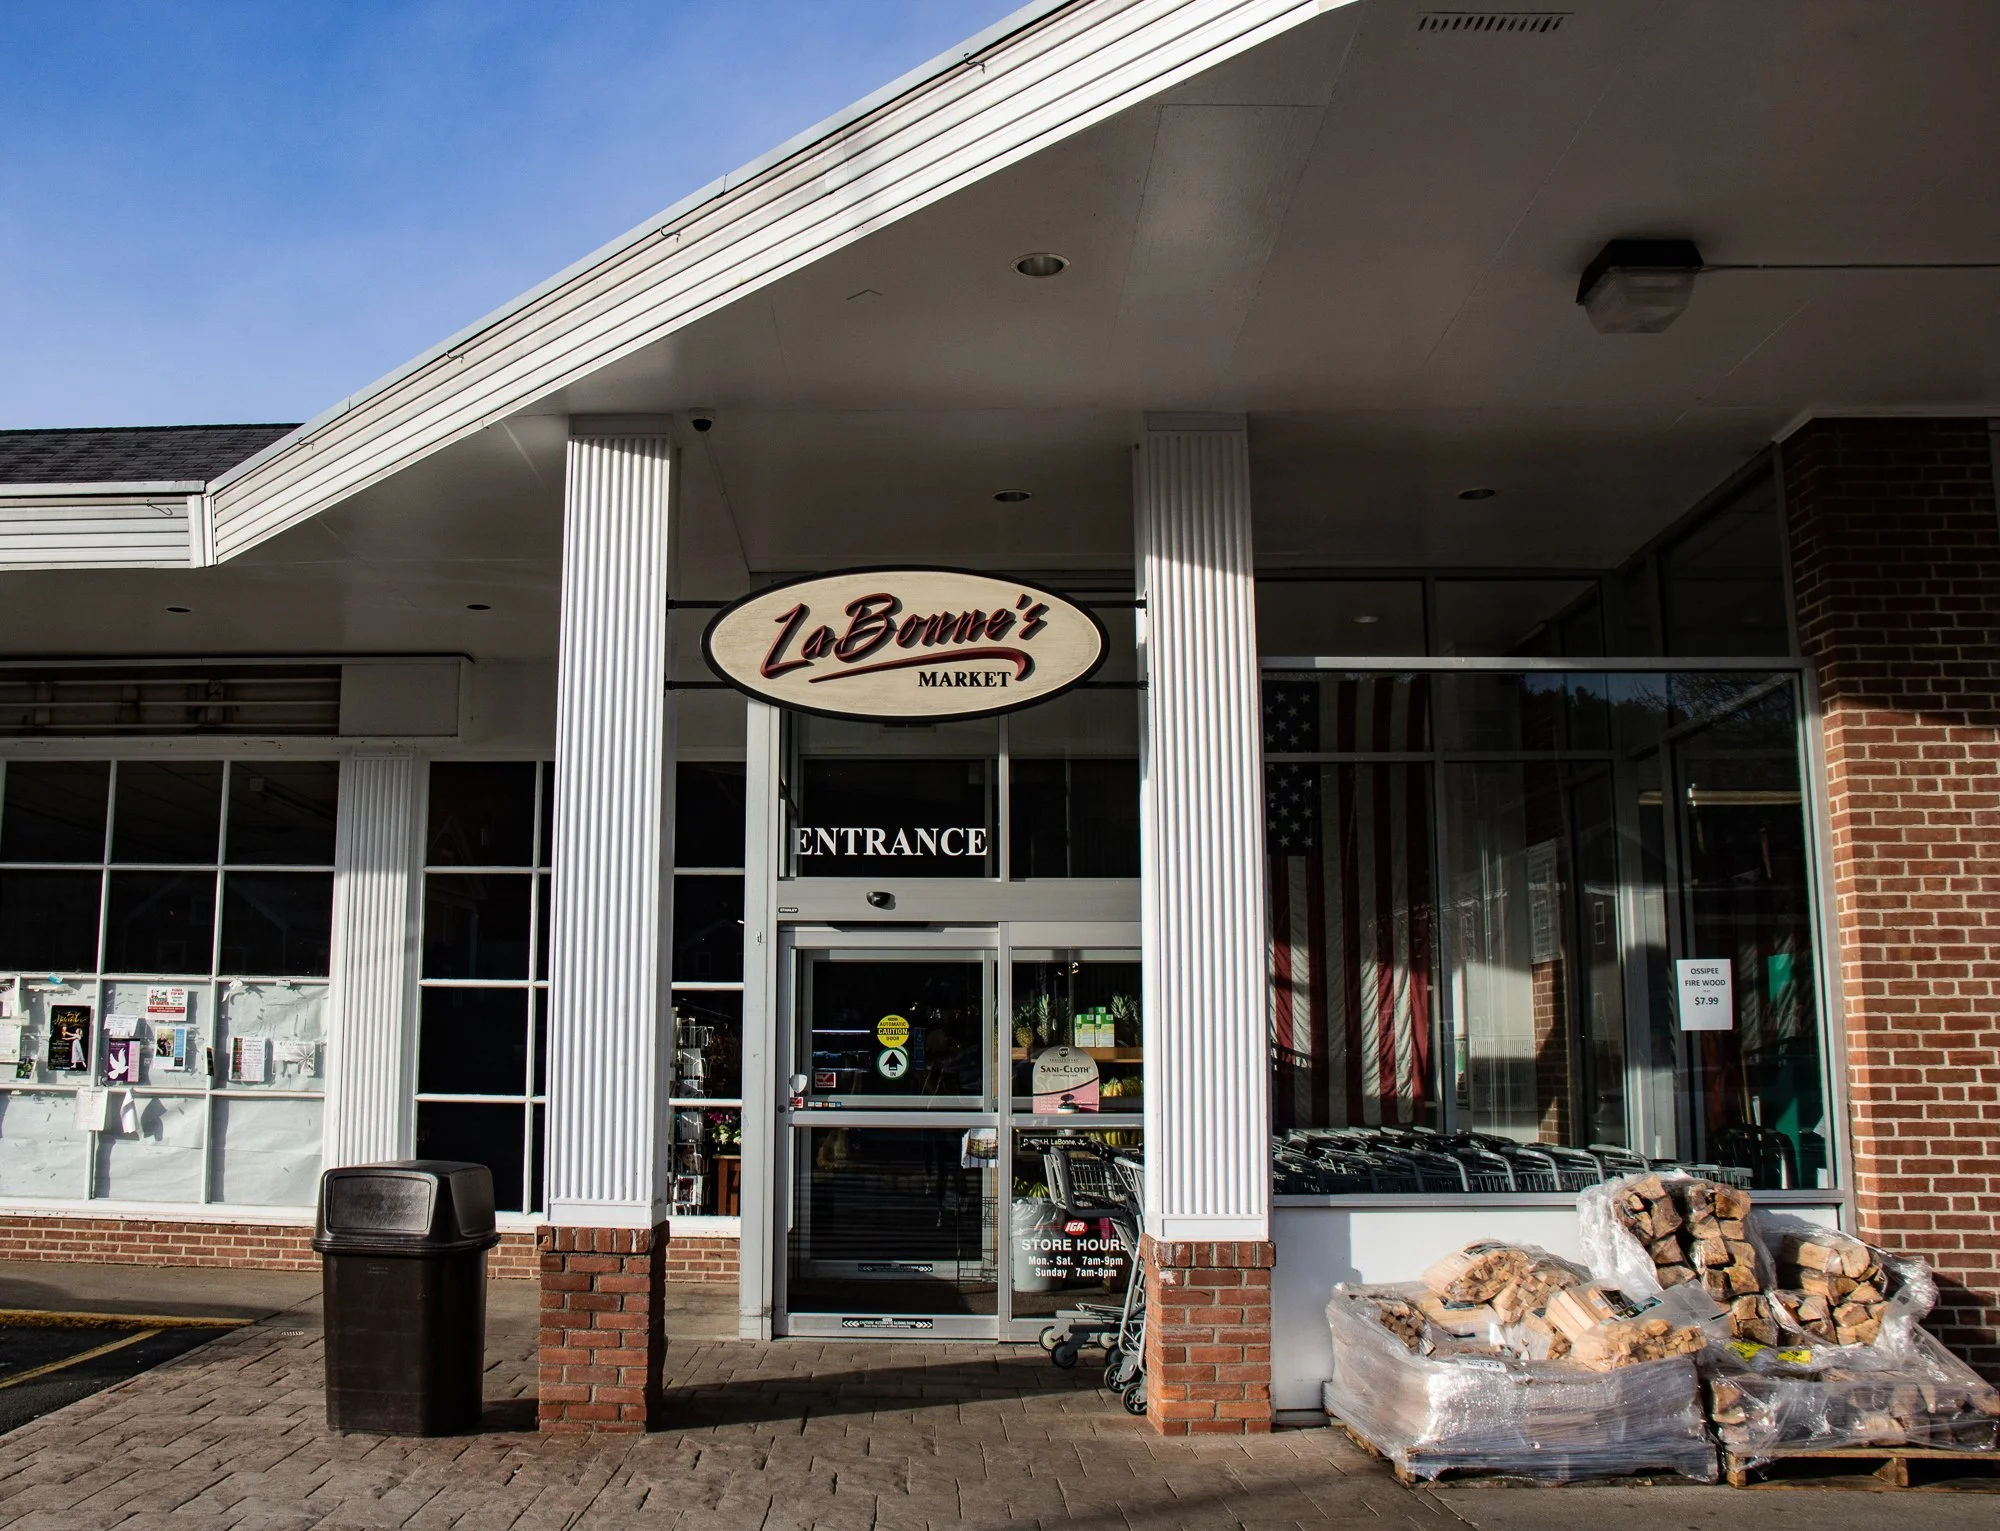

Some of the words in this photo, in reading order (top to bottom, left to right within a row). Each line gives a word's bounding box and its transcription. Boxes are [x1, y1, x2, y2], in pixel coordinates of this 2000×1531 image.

[760, 593, 1050, 680] LaBonne's
[918, 671, 1011, 687] MARKET
[792, 827, 988, 856] ENTRANCE
[1690, 967, 1719, 975] OSSIPEE
[1694, 996, 1719, 1006] $7.99
[1021, 1239, 1072, 1251] STORE
[1056, 1256, 1074, 1265] Sat.
[1082, 1256, 1123, 1267] 7am-9pm
[1035, 1268, 1067, 1278] Sunday
[1075, 1268, 1117, 1278] 7am-8pm
